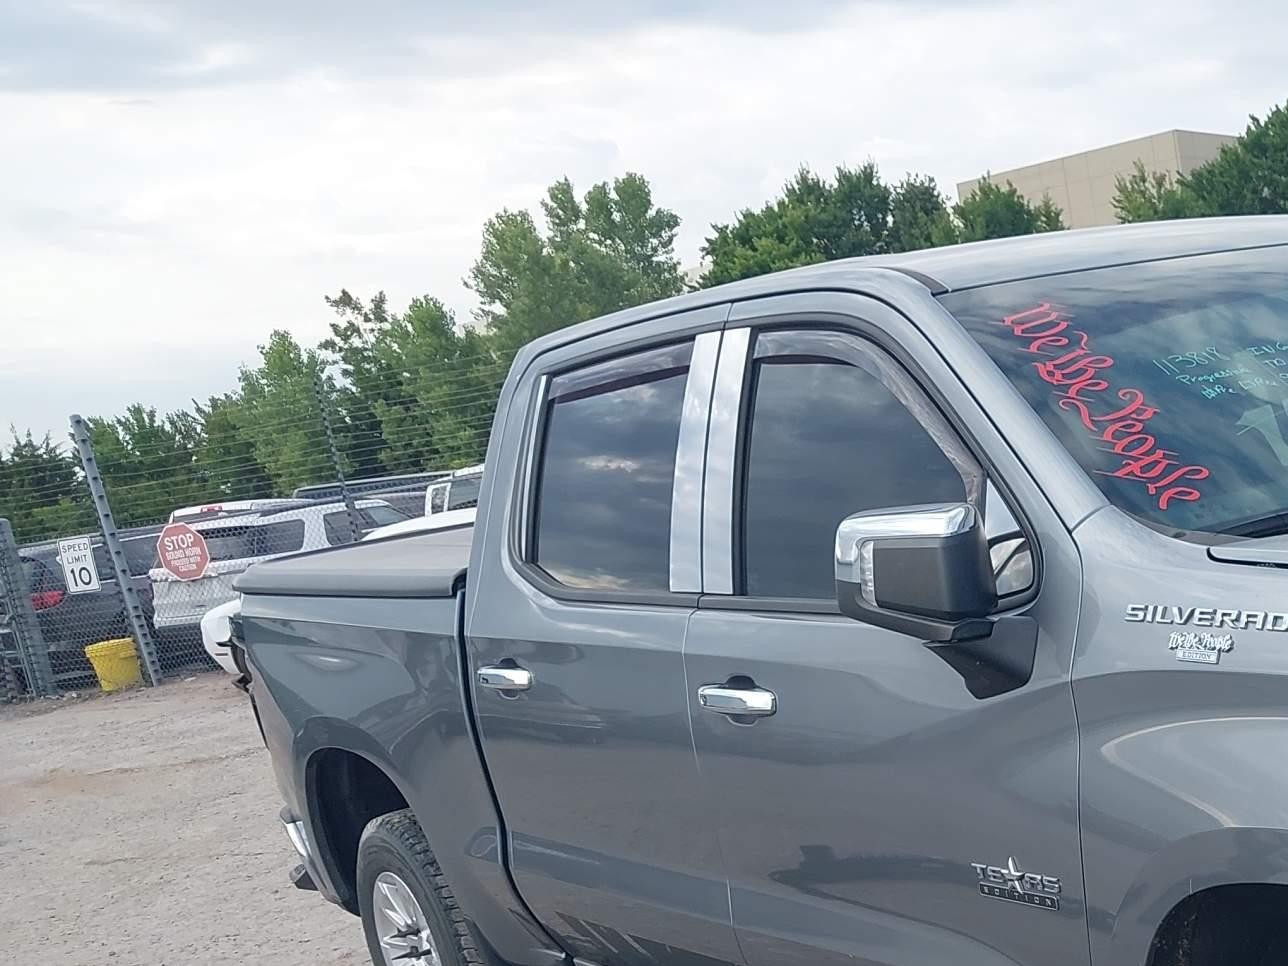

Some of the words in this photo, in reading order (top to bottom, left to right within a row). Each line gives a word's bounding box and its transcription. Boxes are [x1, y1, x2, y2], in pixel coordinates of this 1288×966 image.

[61, 542, 89, 554] SPEED
[164, 533, 194, 551] STOP
[66, 554, 88, 565] LIMIT
[70, 566, 92, 588] 10
[983, 886, 1053, 907] EDITION
